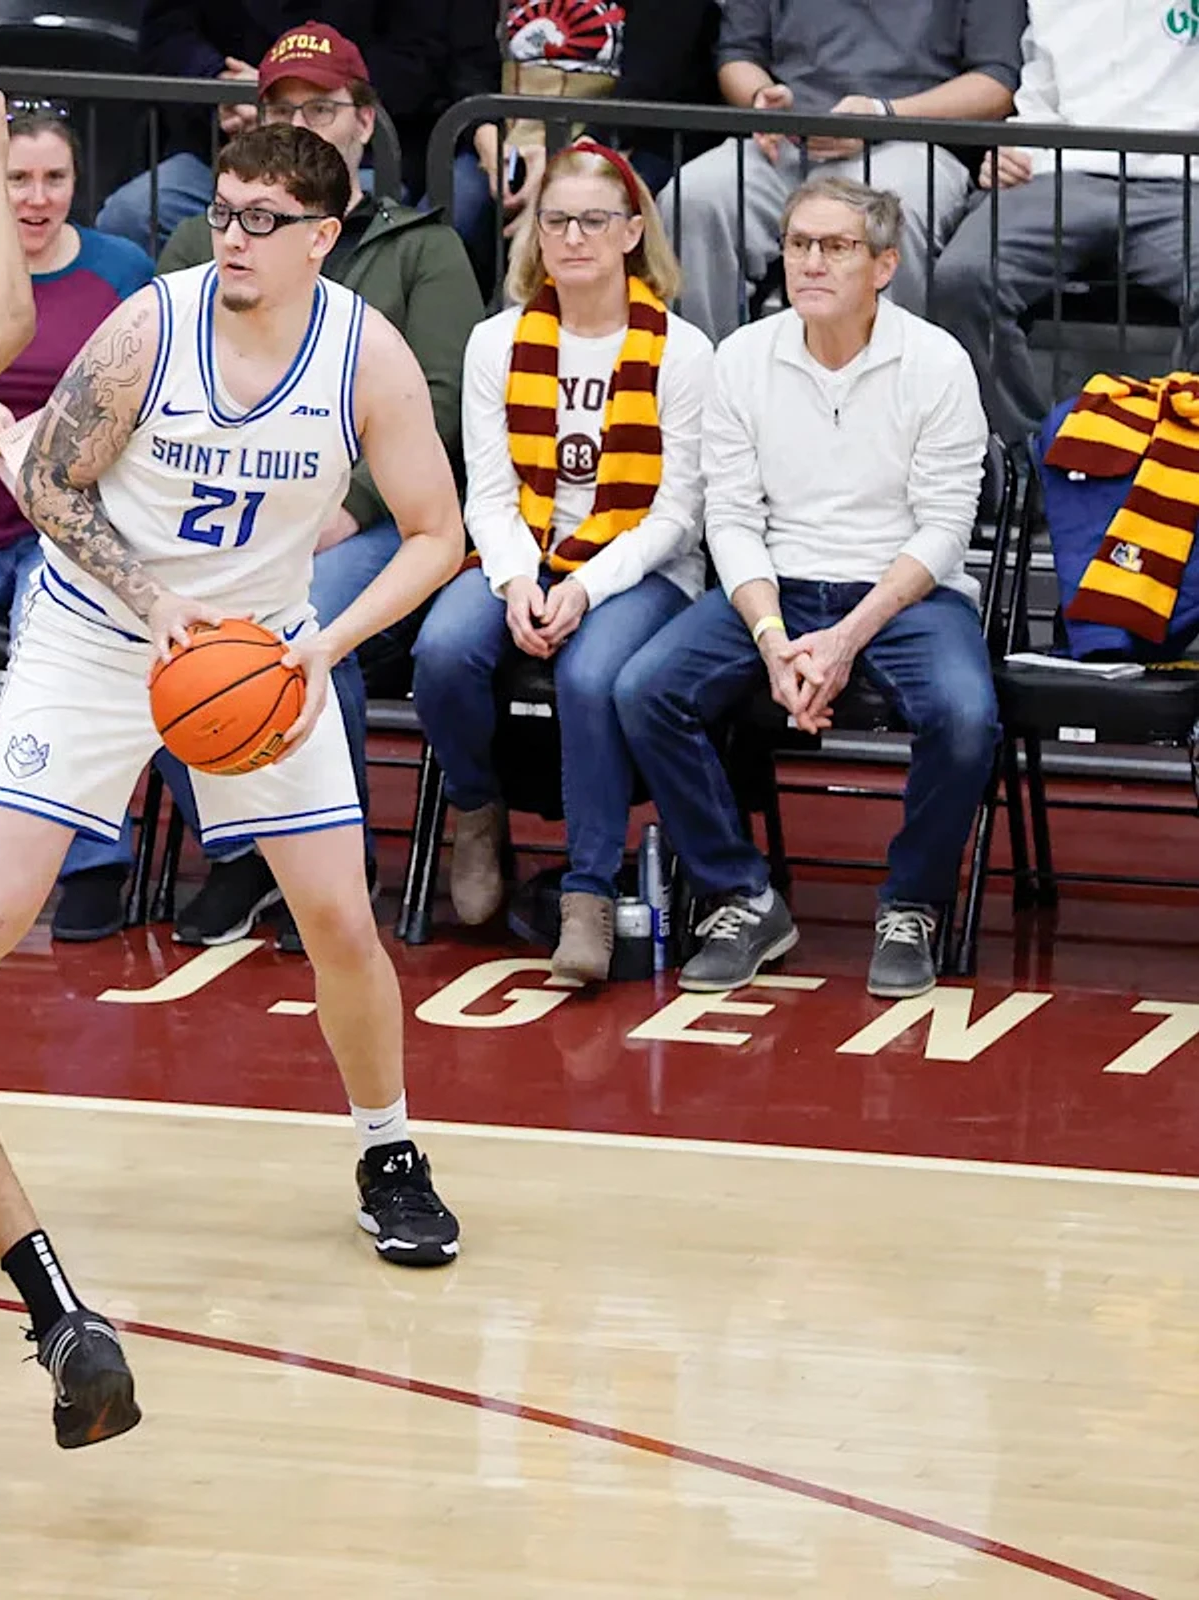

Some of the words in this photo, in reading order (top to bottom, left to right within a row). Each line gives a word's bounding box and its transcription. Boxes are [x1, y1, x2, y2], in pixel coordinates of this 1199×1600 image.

[289, 405, 330, 417] A10
[152, 435, 231, 476] SAINT
[238, 447, 319, 480] LOUIS
[562, 443, 593, 470] 63
[177, 481, 266, 547] 21
